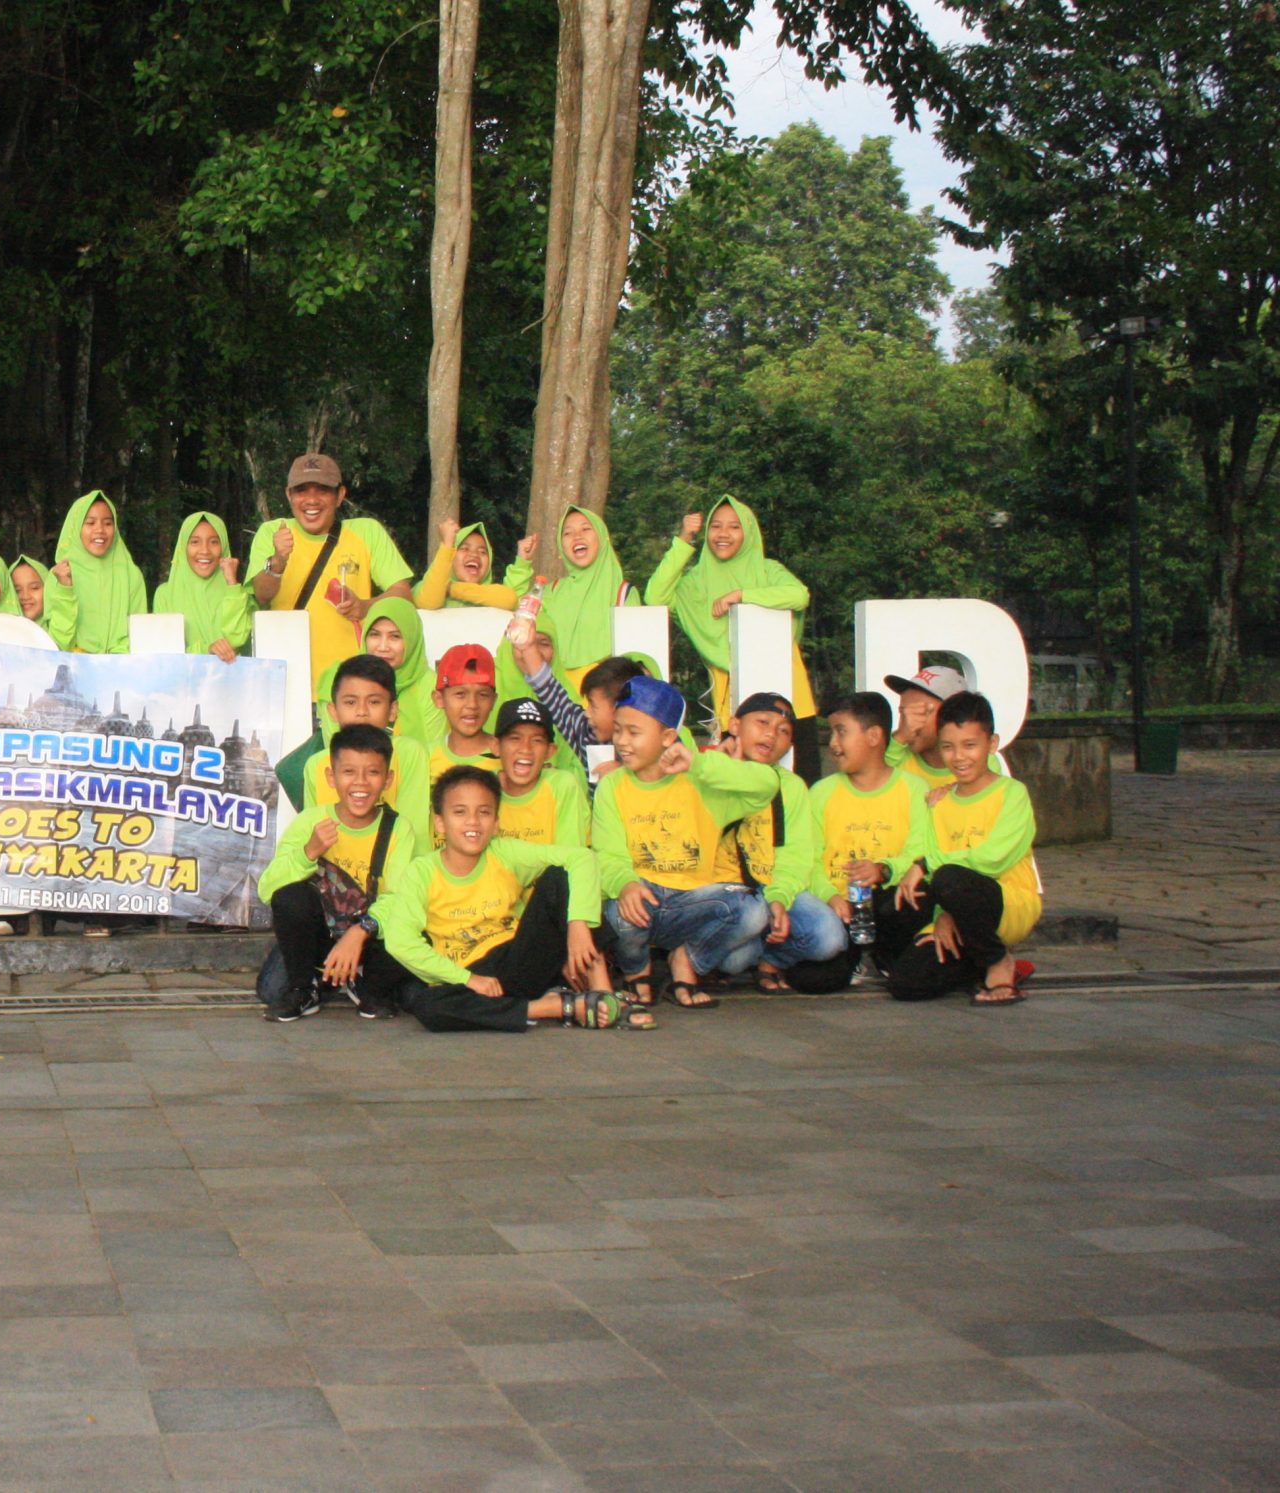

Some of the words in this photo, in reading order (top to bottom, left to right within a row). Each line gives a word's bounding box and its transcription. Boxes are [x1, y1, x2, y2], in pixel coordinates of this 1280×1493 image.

[190, 745, 225, 784] 2
[90, 809, 155, 847] TO
[629, 813, 656, 825] Study
[661, 810, 681, 821] Tour
[18, 889, 111, 911] FEBRUARI
[117, 894, 170, 914] 2018
